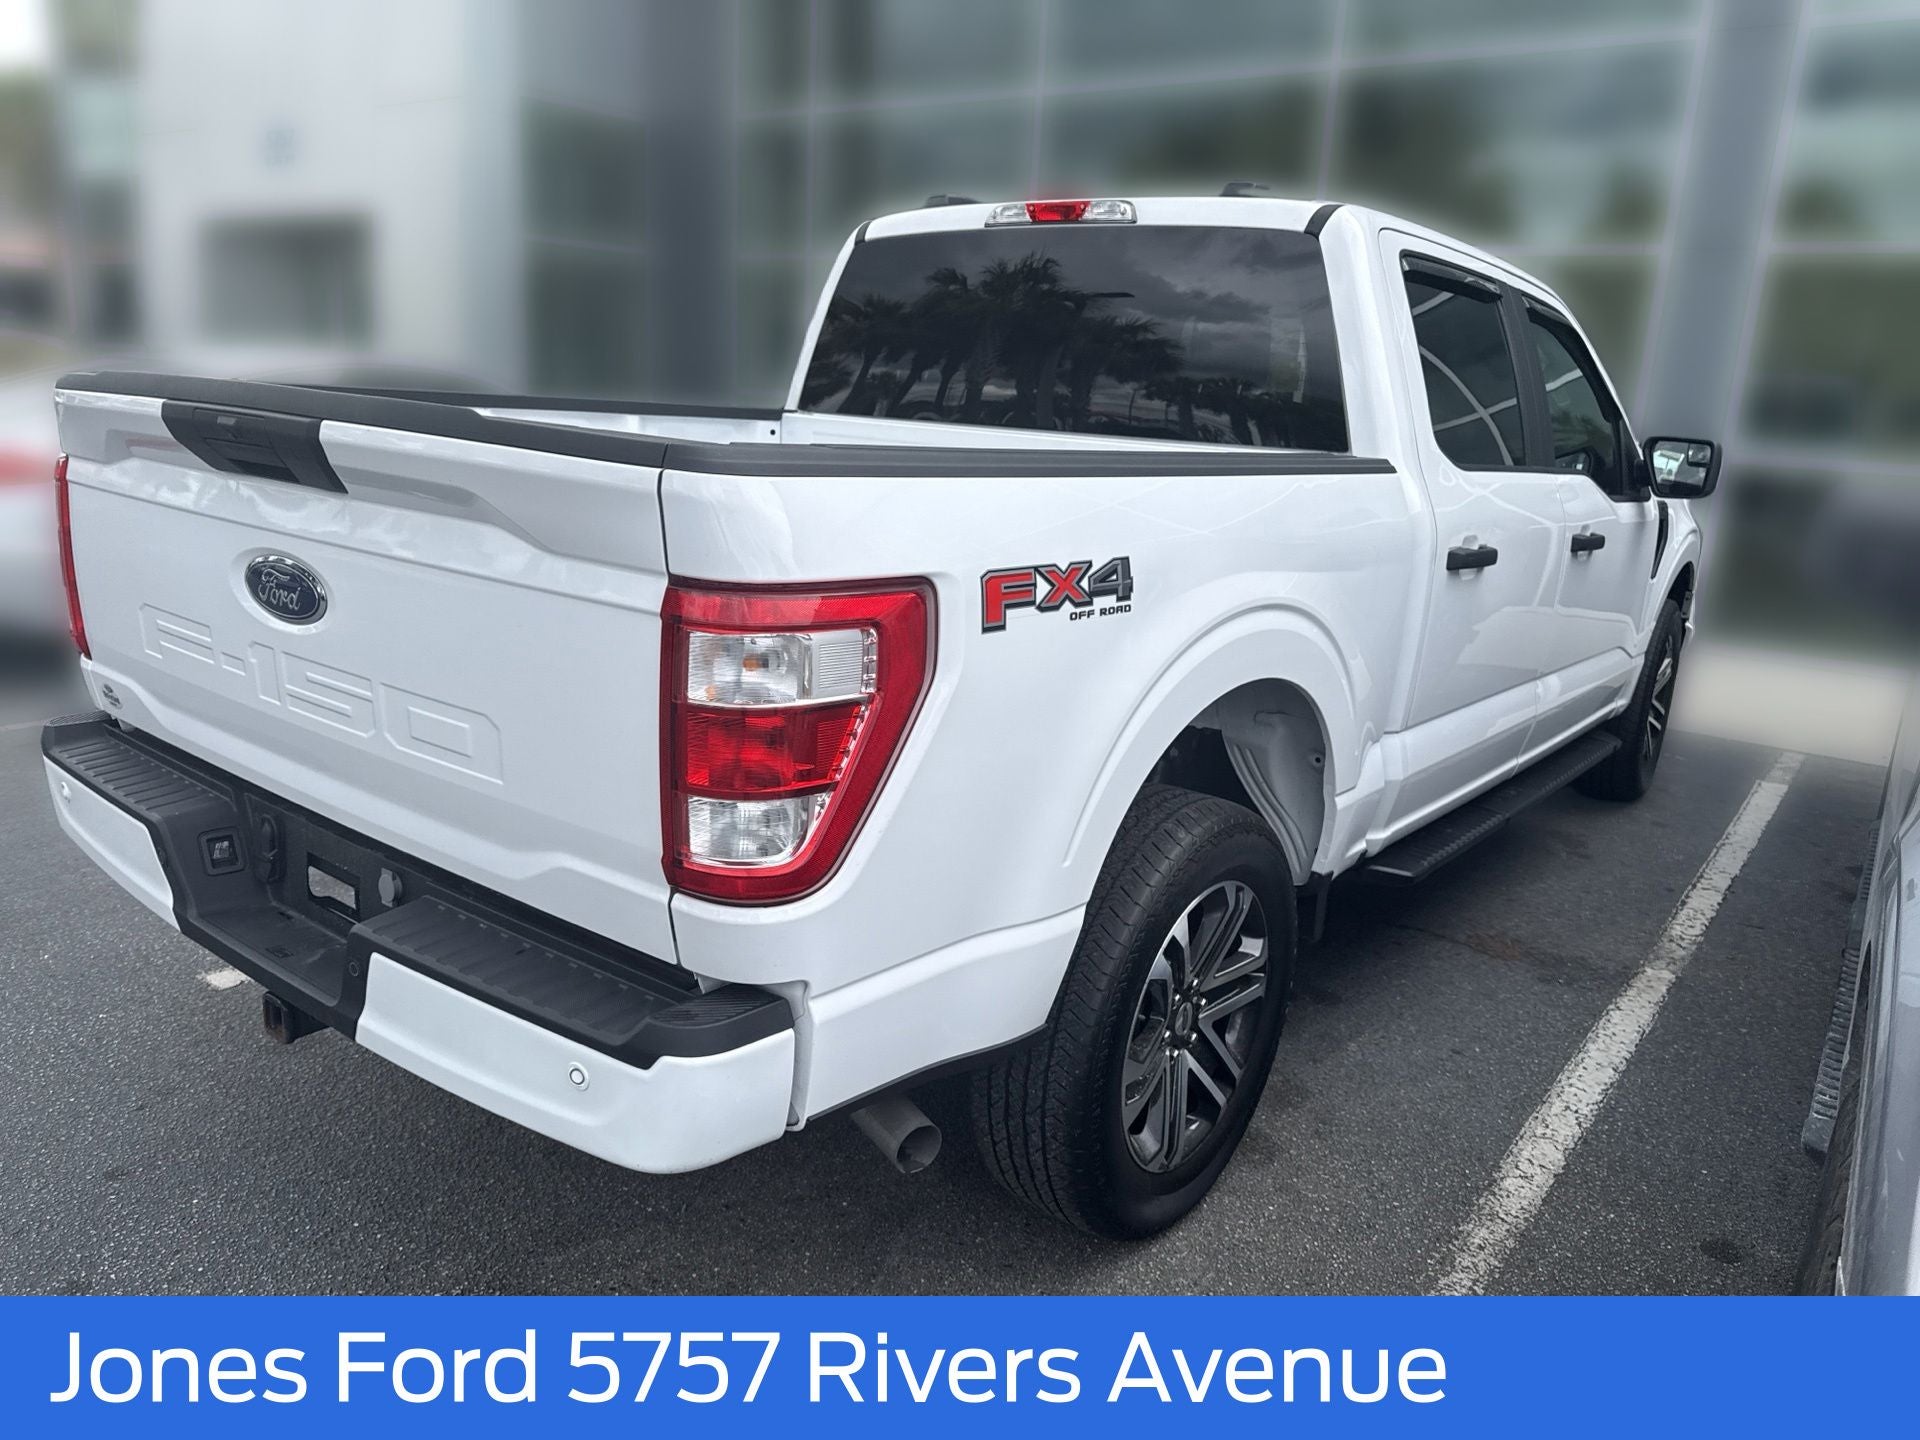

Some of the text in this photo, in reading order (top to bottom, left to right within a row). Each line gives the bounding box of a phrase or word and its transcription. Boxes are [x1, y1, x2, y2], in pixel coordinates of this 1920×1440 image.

[257, 567, 302, 611] Ford
[980, 555, 1134, 634] FX4
[1069, 603, 1132, 621] OFF ROAD
[138, 602, 504, 785] F-150
